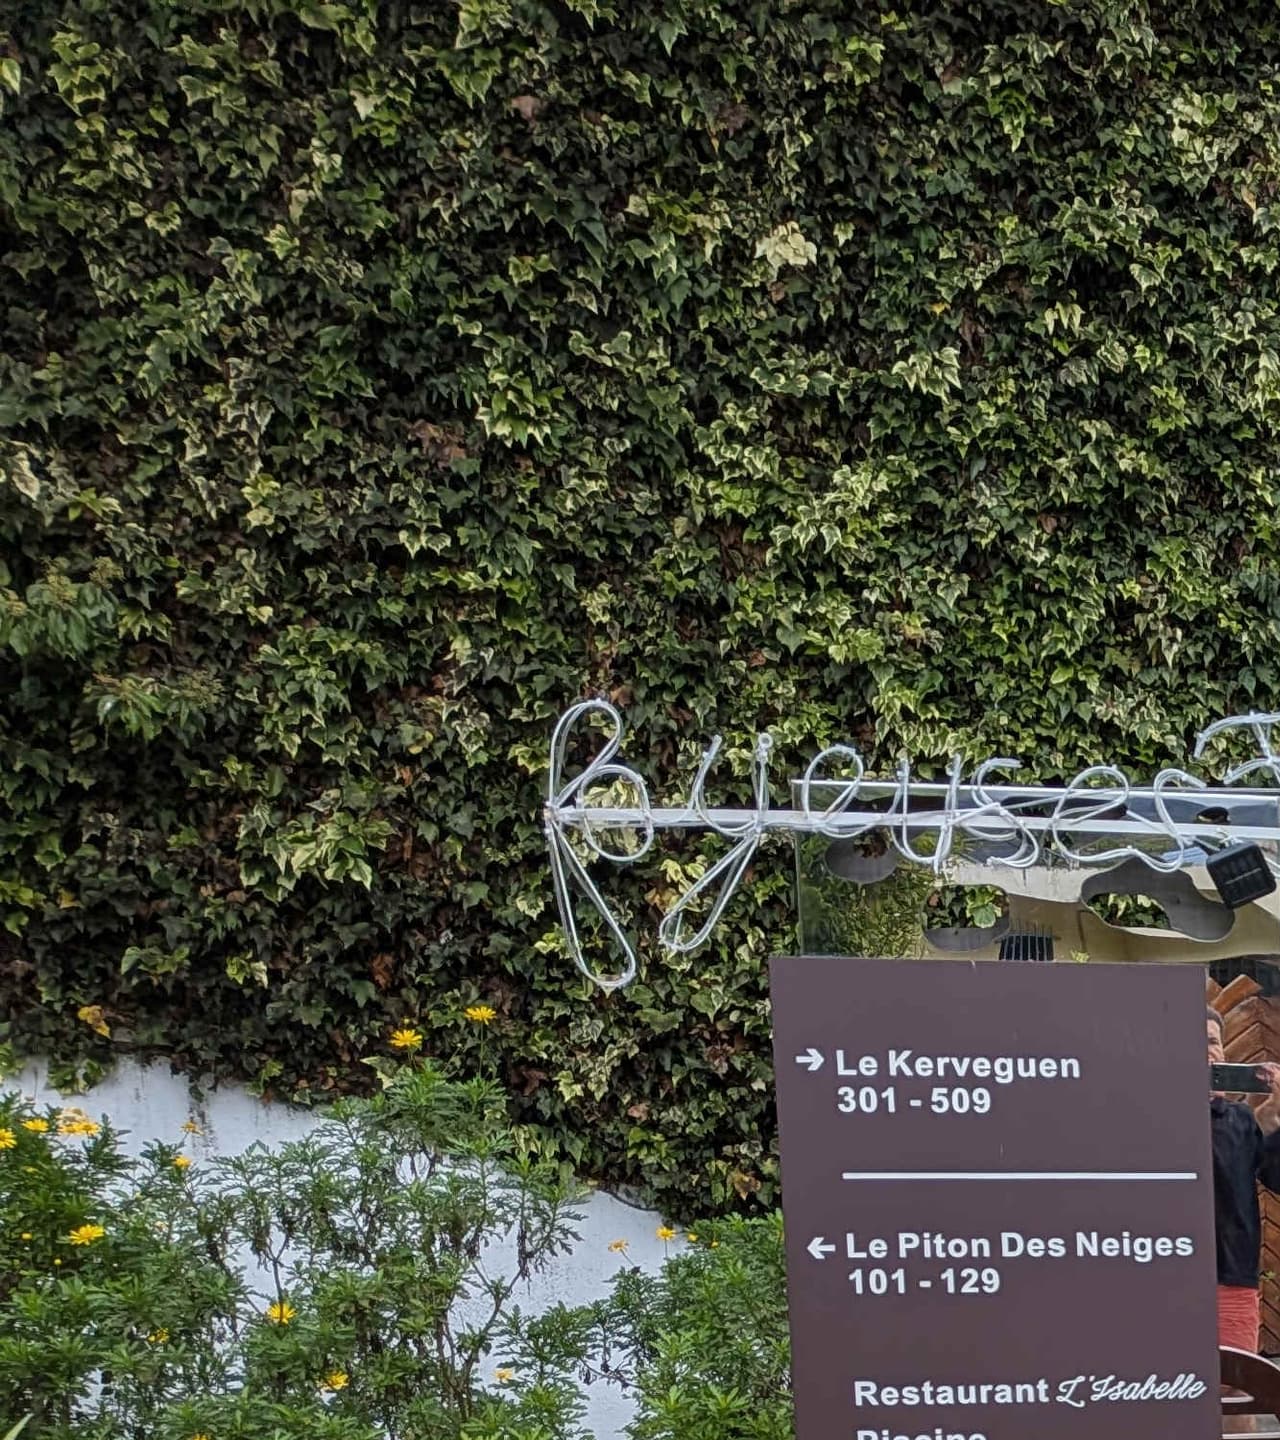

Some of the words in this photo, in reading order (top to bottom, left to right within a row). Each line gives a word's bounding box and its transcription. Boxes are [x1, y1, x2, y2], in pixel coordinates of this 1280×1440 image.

[835, 1049, 879, 1077] Le
[888, 1049, 1081, 1083] Kerveguen
[837, 1086, 896, 1113] 301
[930, 1087, 991, 1114] 509
[846, 1232, 888, 1259] Le
[898, 1232, 991, 1259] Piton
[1000, 1231, 1067, 1258] Des
[1075, 1231, 1194, 1263] Neiges
[848, 1268, 906, 1295] 101
[940, 1267, 1000, 1294] 129
[854, 1378, 1050, 1407] Restaurant
[1055, 1373, 1207, 1408] L'Isabelle
